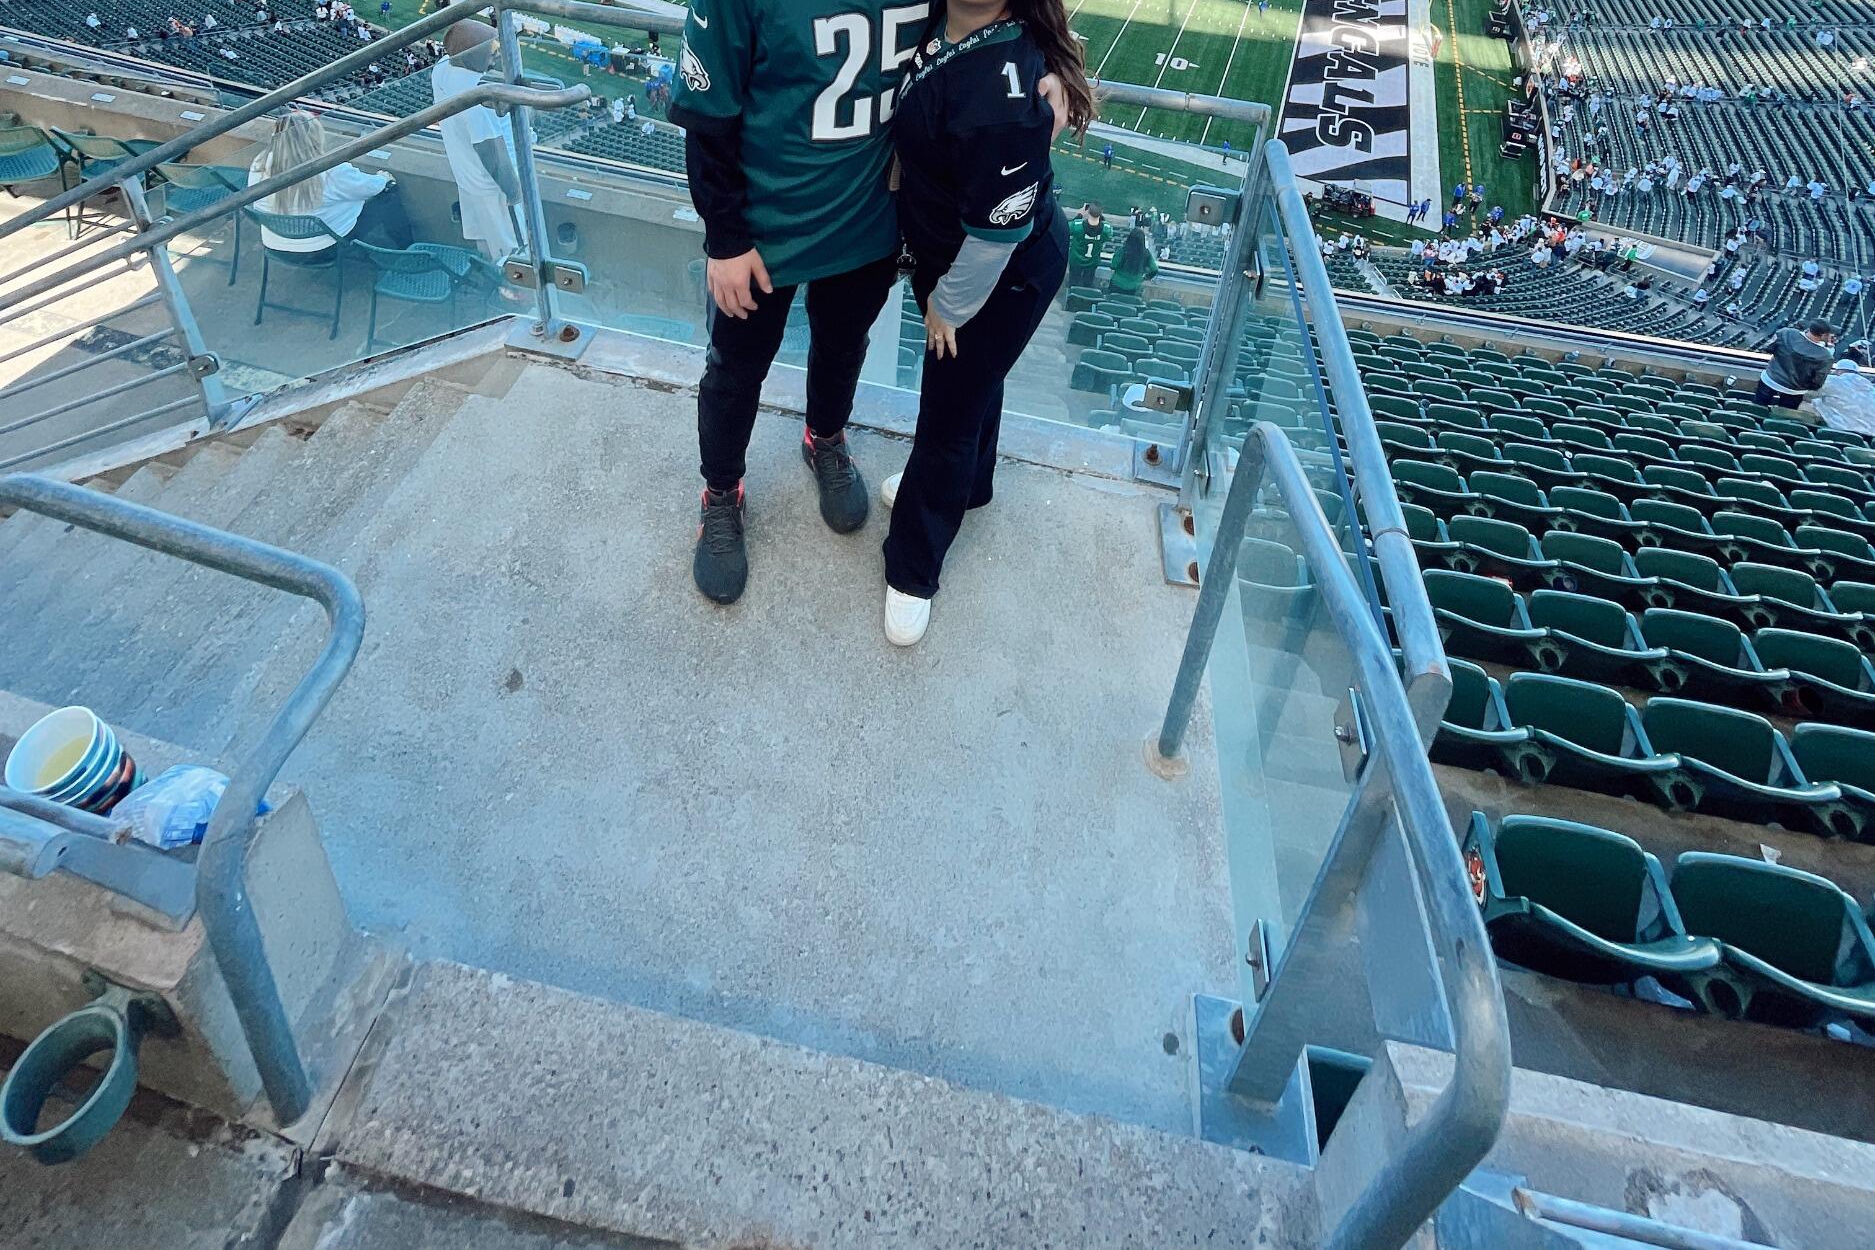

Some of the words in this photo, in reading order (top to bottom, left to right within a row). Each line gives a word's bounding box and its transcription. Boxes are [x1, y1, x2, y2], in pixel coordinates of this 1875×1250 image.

[958, 34, 980, 52] Eagles
[935, 48, 956, 66] Eagles
[1154, 52, 1189, 71] 10
[810, 1, 930, 141] 25
[1000, 60, 1027, 99] 1
[1084, 243, 1094, 258] 1
